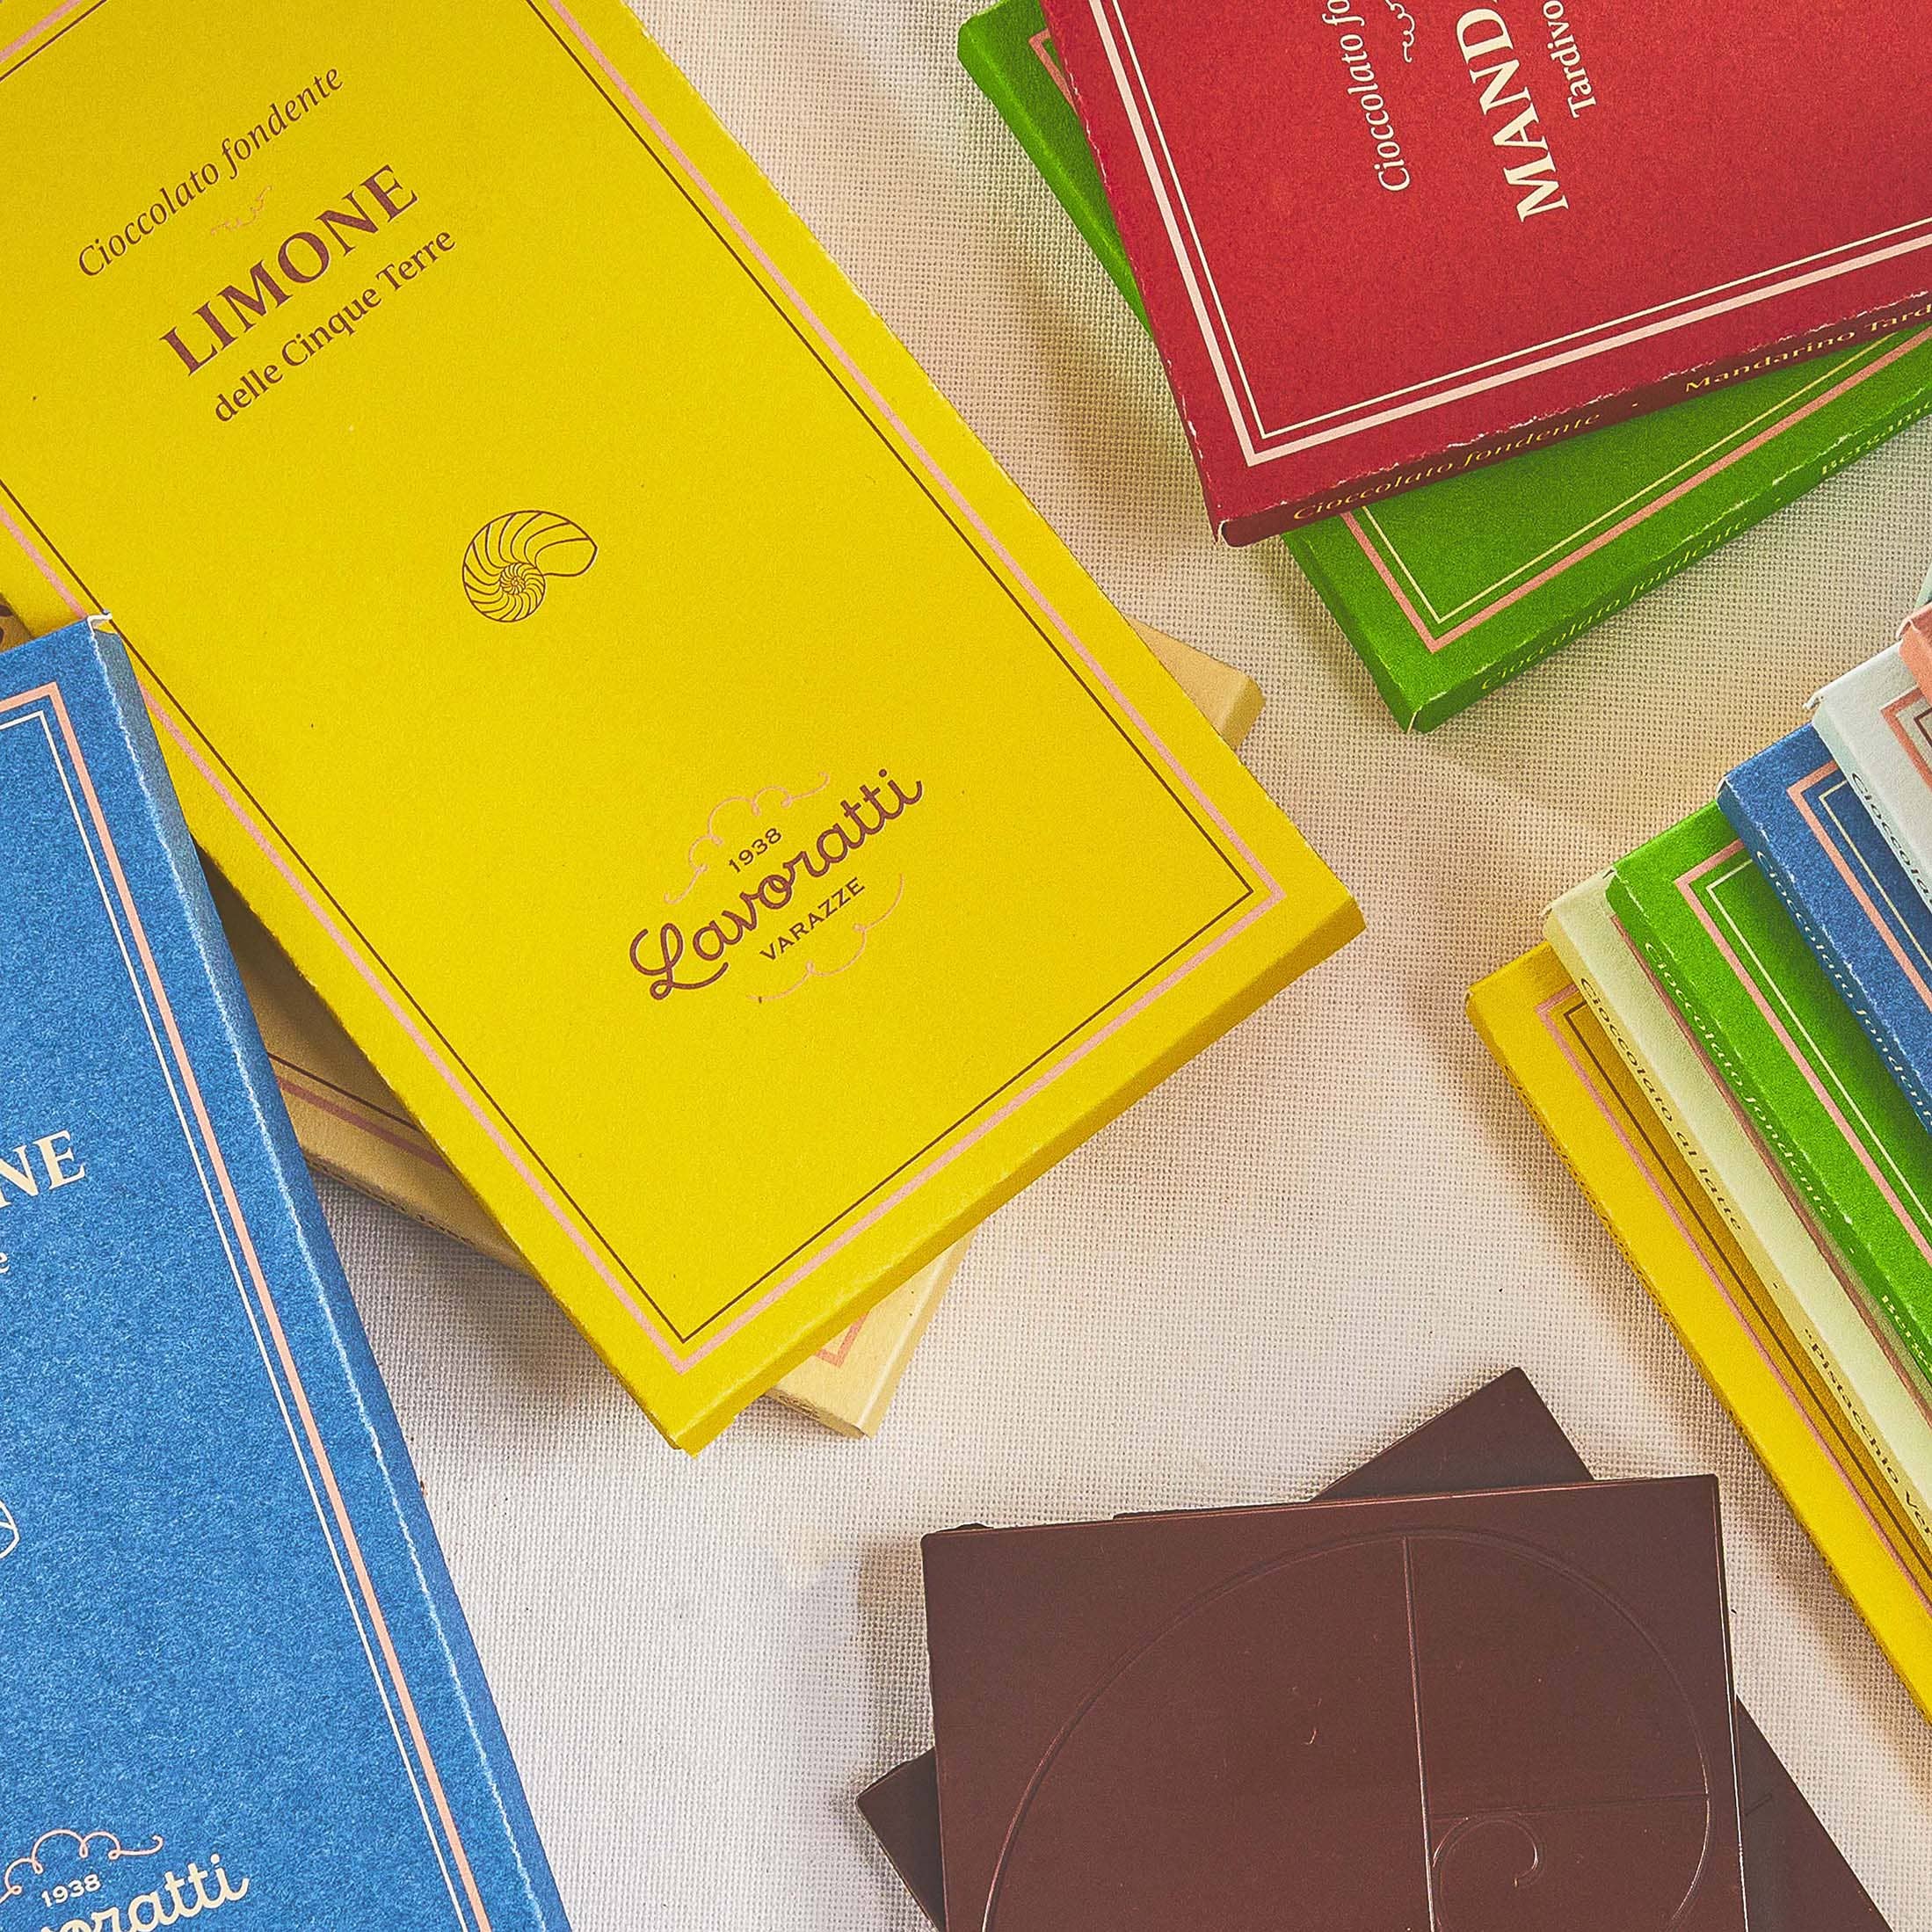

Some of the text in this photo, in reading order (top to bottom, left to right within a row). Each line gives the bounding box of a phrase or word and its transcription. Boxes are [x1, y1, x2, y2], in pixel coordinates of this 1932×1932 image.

[1340, 33, 1411, 192] Cioccolato
[1456, 4, 1570, 222] MAND
[1543, 0, 1597, 120] Tardivo
[78, 68, 344, 277] Cioccolato fondente
[159, 163, 419, 377] LIMONE
[214, 229, 456, 422] delle Cinque Terre
[1293, 462, 1454, 520] Cioccolato
[1458, 414, 1601, 468] fondente
[1685, 331, 1856, 393] Mandarino
[629, 768, 923, 1000] Lavoratti
[728, 827, 782, 874] 1938
[759, 876, 866, 962] VARAZZE
[1645, 942, 1743, 1086] Cioccolato
[1741, 1093, 1831, 1218] fondente
[1757, 850, 1932, 1126] Cioccolato fondent
[1580, 977, 1674, 1122] Cioccolato
[1675, 1130, 1697, 1157] al
[1699, 1168, 1741, 1230] latte
[41, 1873, 102, 1907] 1938
